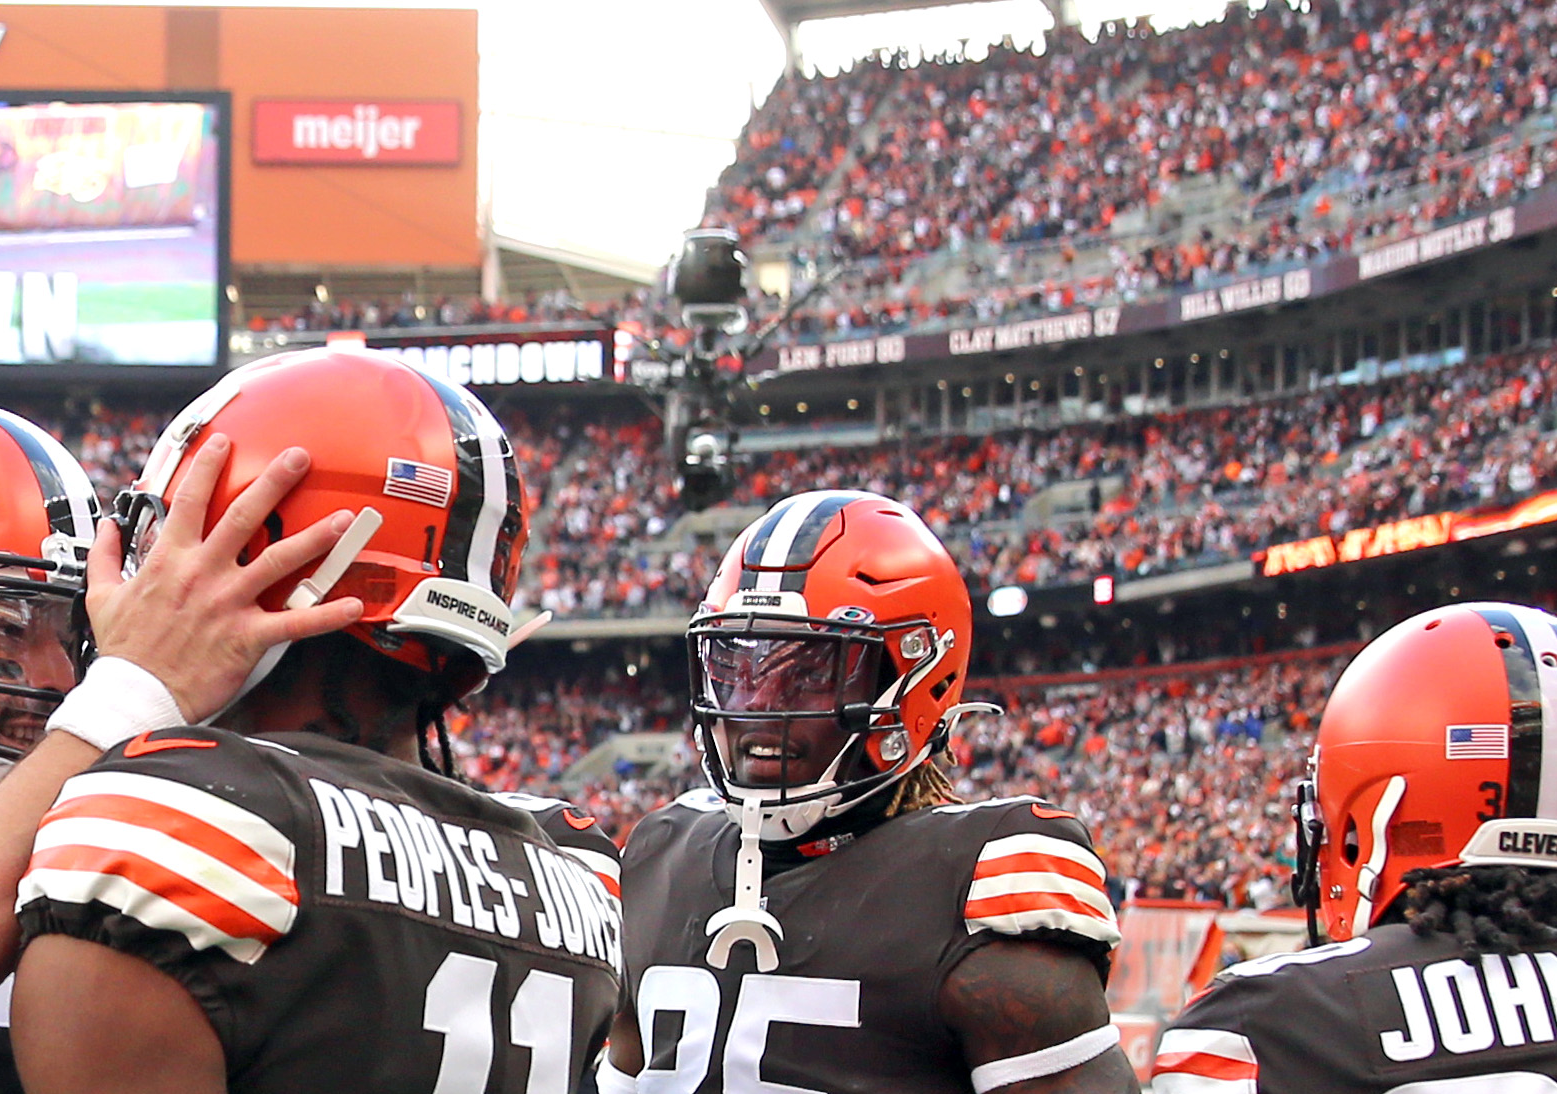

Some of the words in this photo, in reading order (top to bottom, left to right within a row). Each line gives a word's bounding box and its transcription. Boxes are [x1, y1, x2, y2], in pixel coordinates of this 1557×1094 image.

[293, 104, 422, 159] meijer
[949, 327, 993, 356] CLAY
[994, 312, 1092, 349] MATTHEWS
[381, 340, 603, 387] OUCHDOWN
[426, 589, 477, 620] INSPIRE
[477, 609, 510, 637] CHANGE
[1477, 781, 1502, 821] 3
